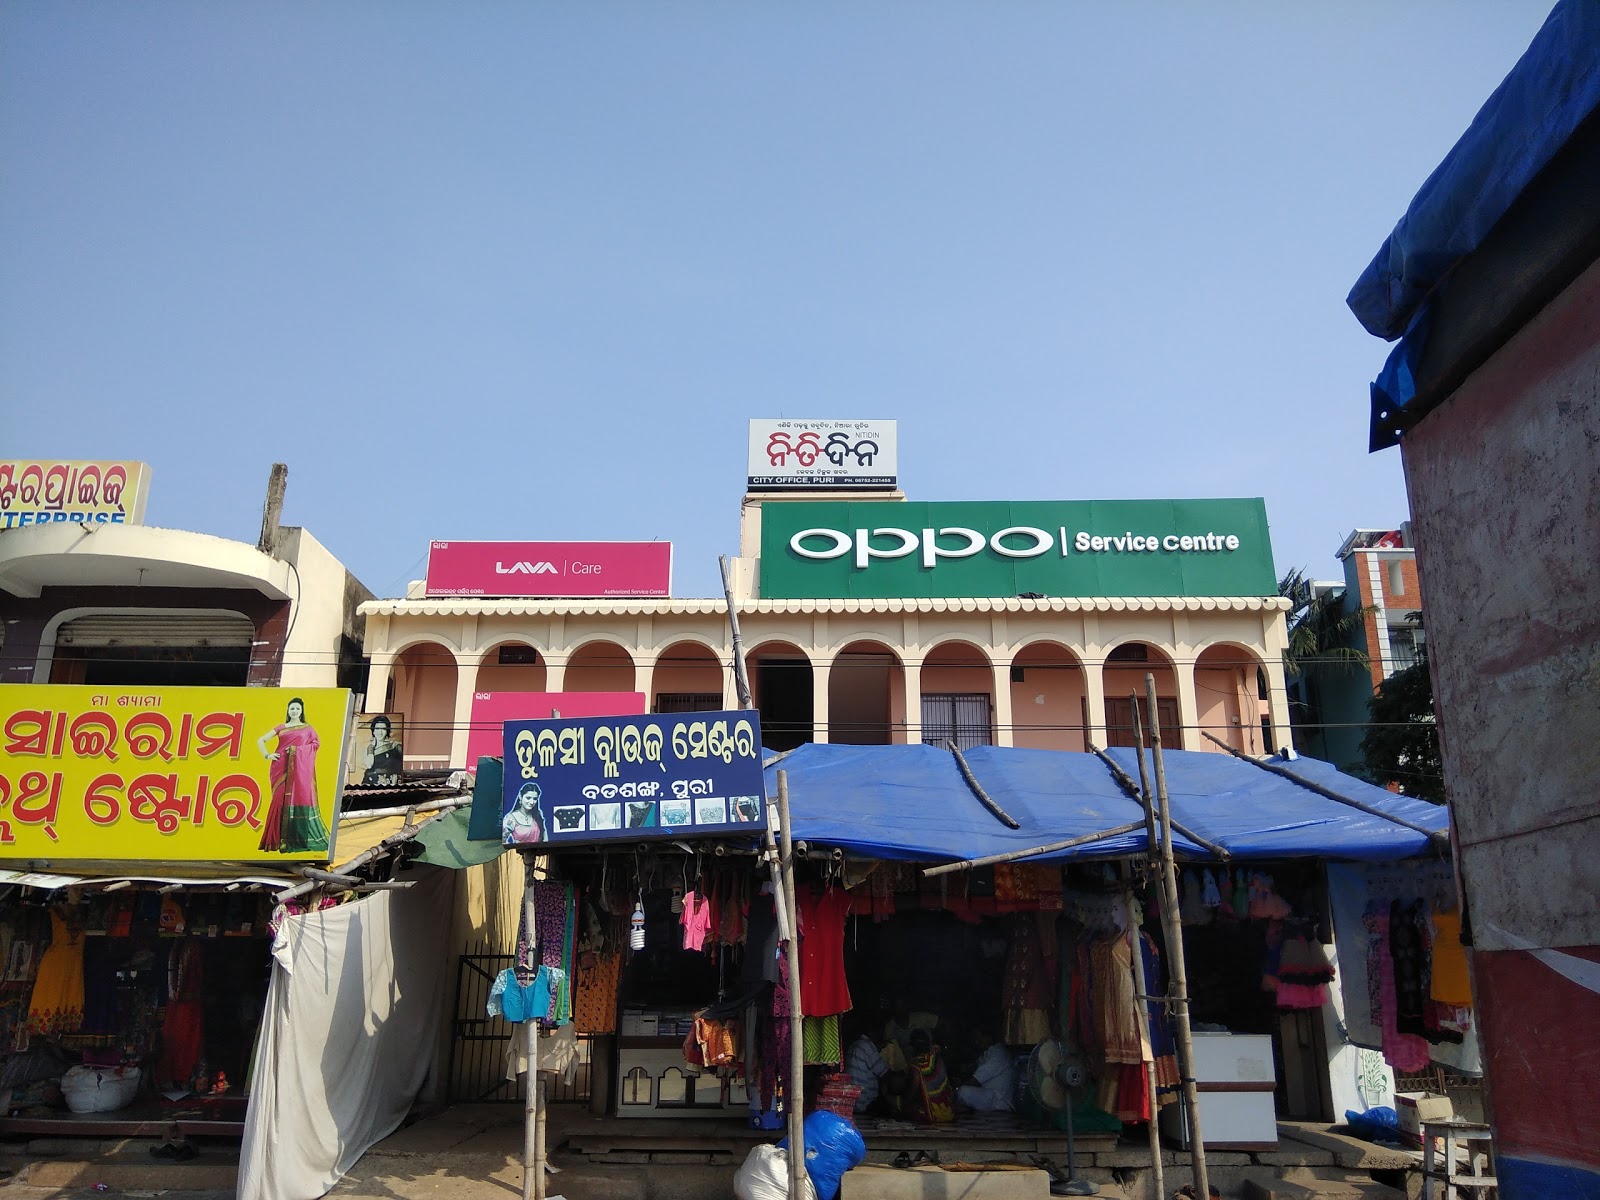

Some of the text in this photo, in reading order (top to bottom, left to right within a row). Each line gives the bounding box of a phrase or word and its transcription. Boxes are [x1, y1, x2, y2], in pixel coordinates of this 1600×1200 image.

[775, 477, 811, 485] OFFICE,
[1074, 531, 1159, 553] Service
[1162, 532, 1240, 552] centre
[495, 561, 602, 575] LAVA Care
[91, 695, 109, 706] ମା
[4, 710, 244, 760] ସାଇରାମ
[515, 727, 585, 779] ତୁଳସୀ
[672, 719, 757, 764] ସେଣ୍ଟର
[671, 778, 714, 799] ପୁରୀ
[83, 773, 262, 833] ଷ୍ଟୋର
